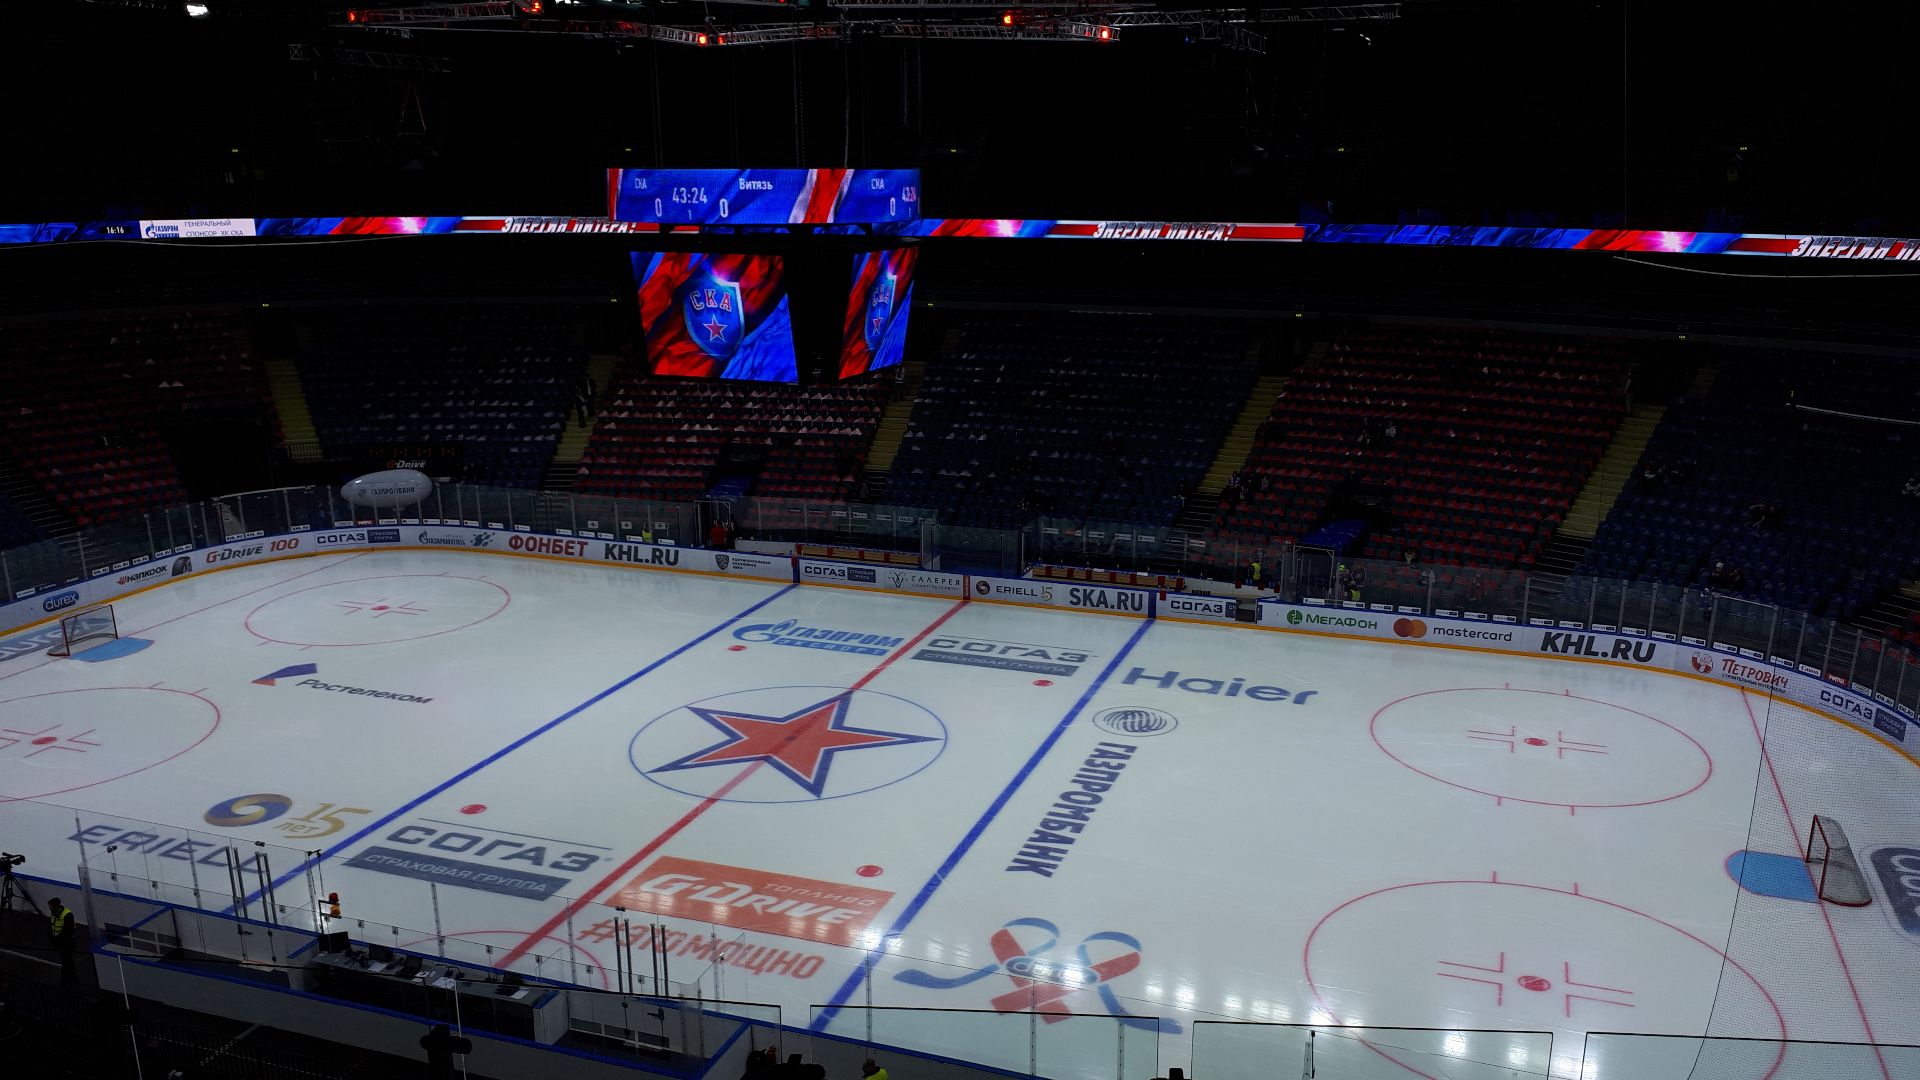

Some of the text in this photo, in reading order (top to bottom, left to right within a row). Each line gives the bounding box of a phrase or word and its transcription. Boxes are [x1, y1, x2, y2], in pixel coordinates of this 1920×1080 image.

[671, 187, 708, 204] 43:24
[889, 196, 897, 217] 0
[654, 197, 663, 218] 0
[719, 198, 729, 219] 0
[106, 226, 125, 235] 16:16
[184, 220, 232, 228] ГЕНЕРАЛЬНЫЙ
[1093, 221, 1165, 240] ЭНЕРГИЯ
[1791, 235, 1898, 260] ЭНЕРГИЯ
[689, 288, 732, 312] СКА
[269, 538, 300, 552] 100
[317, 533, 366, 545] СОГАЗ
[508, 535, 589, 557] ФОНБЕТ
[604, 543, 680, 566] KHL.RU
[804, 565, 846, 577] СОГАЗ
[911, 574, 960, 587] ГАЛЕРЕЯ
[45, 593, 78, 610] durex
[996, 585, 1054, 602] ERIELL 15
[1069, 587, 1144, 612] SKA.RU
[1170, 599, 1223, 614] СОГАЗ
[786, 626, 906, 648] ГАЗПРОМ
[1433, 626, 1513, 642] mastercard
[927, 638, 1089, 664] СОГАЗ
[1540, 631, 1657, 663] KHL.RU
[923, 652, 1068, 673] СТРАХОВАЯ ГРУППА
[1722, 658, 1789, 689] ПЕТРОВИЧ
[295, 678, 434, 705] Ростелеком
[1121, 666, 1320, 705] Haier
[1820, 690, 1874, 720] СОГАЗ
[283, 802, 373, 839] 15
[1004, 741, 1139, 879] ГАЗПРОМБАНК
[271, 821, 320, 835] лет
[67, 824, 266, 874] ERIELL
[385, 825, 601, 873] СОГАЗ
[363, 853, 548, 893] СТРАХОВАЯ ГРУППА
[761, 882, 882, 907] ТОПЛИВО
[576, 918, 827, 980] #ЭТОМОЩНО
